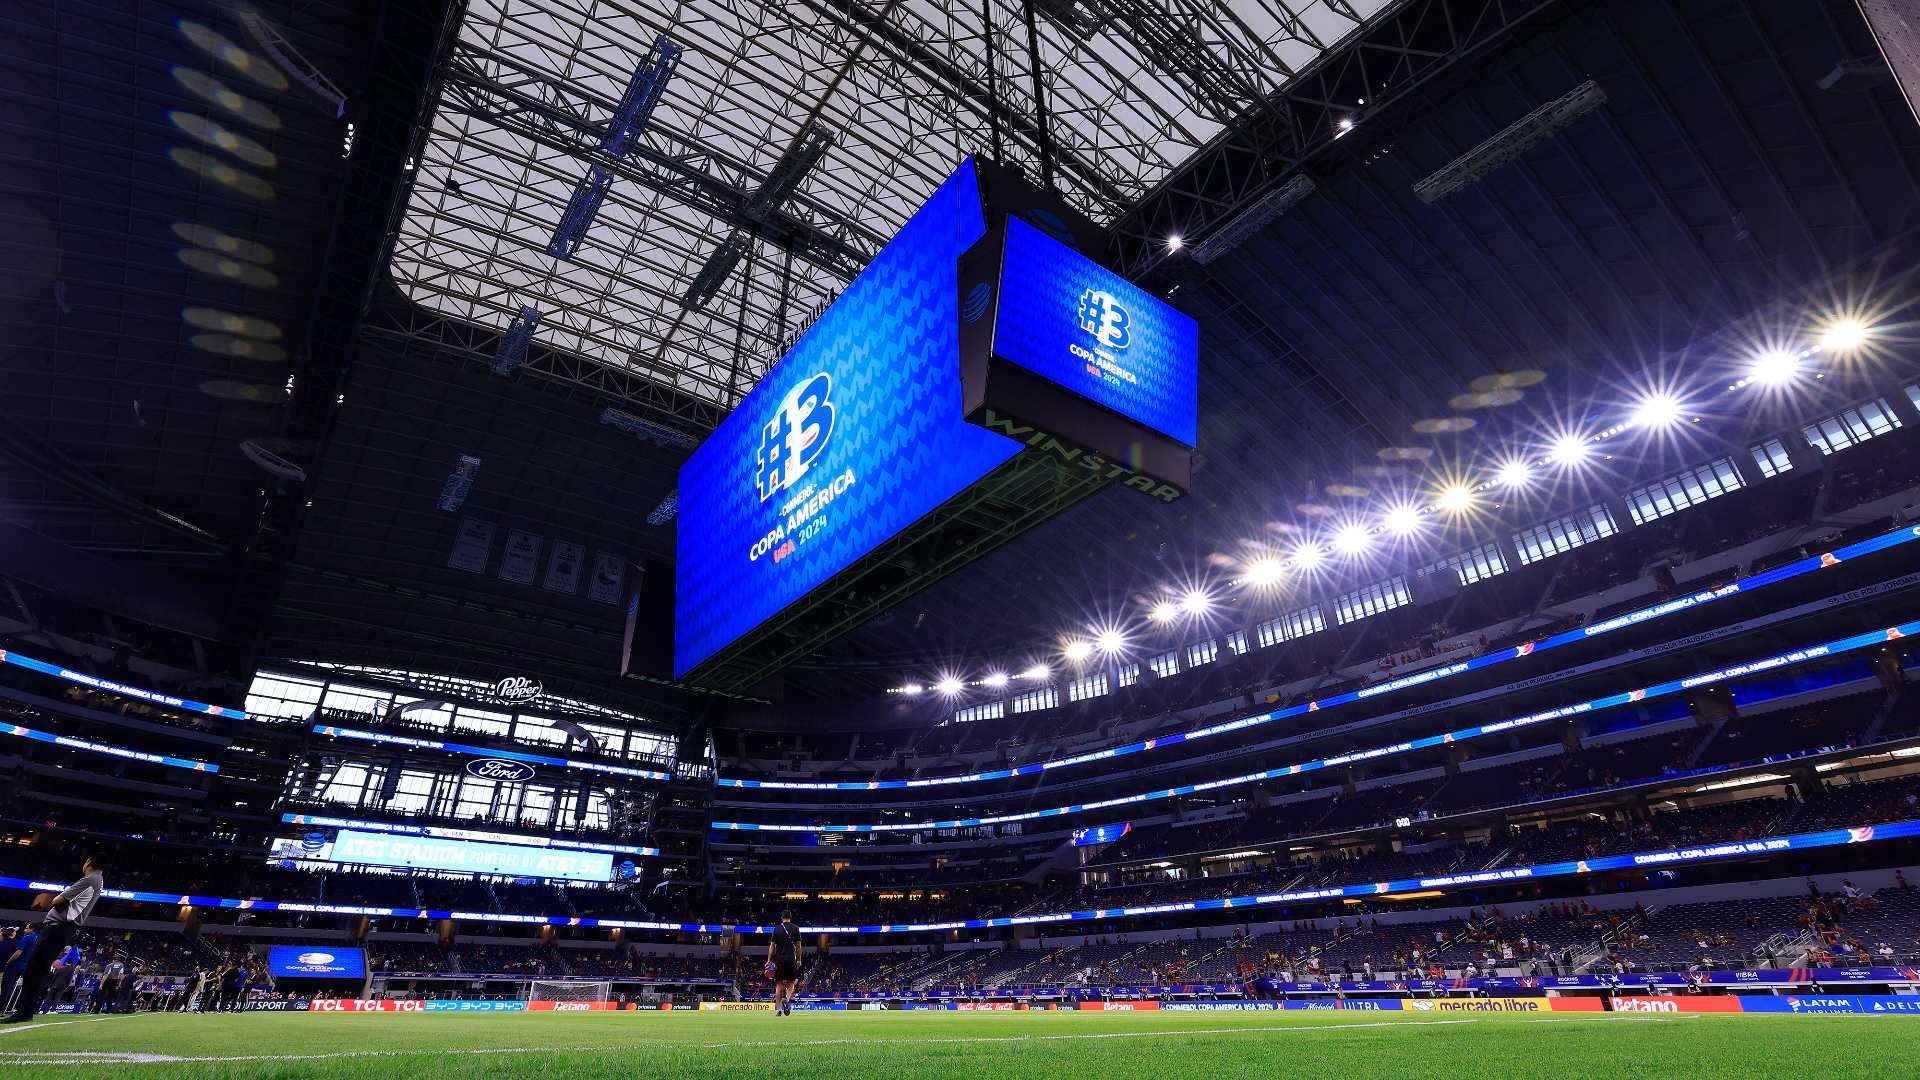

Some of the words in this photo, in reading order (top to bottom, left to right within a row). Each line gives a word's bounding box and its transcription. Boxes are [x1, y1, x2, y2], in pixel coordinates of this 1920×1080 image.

[1070, 344, 1095, 364] COPA
[1096, 357, 1137, 385] AMERICA
[1086, 363, 1102, 378] USA
[1103, 372, 1121, 387] 2024
[985, 409, 1182, 502] WINSTAR
[750, 525, 785, 561] COPA
[786, 468, 857, 535] AMERICA
[773, 539, 796, 563] USA
[798, 514, 828, 545] 2024
[498, 677, 540, 699] Pepper
[515, 676, 533, 688] Dr
[478, 760, 524, 779] Ford
[341, 839, 385, 859] AT&T
[388, 842, 466, 864] STADIUM
[470, 851, 524, 867] POWERED
[537, 855, 578, 873] AT&T
[256, 1001, 288, 1010] SPORT
[312, 1000, 344, 1010] TCL
[354, 1000, 384, 1010] TCL
[394, 1000, 424, 1010] TCL
[720, 1002, 752, 1010] mercado
[754, 1002, 769, 1010] libre
[1103, 1002, 1134, 1010] Betano
[1440, 998, 1502, 1011] mercado
[1504, 998, 1538, 1011] libre
[1612, 997, 1678, 1012] Betano
[1801, 999, 1851, 1007] LATAM
[1886, 1001, 1920, 1011] DELT
